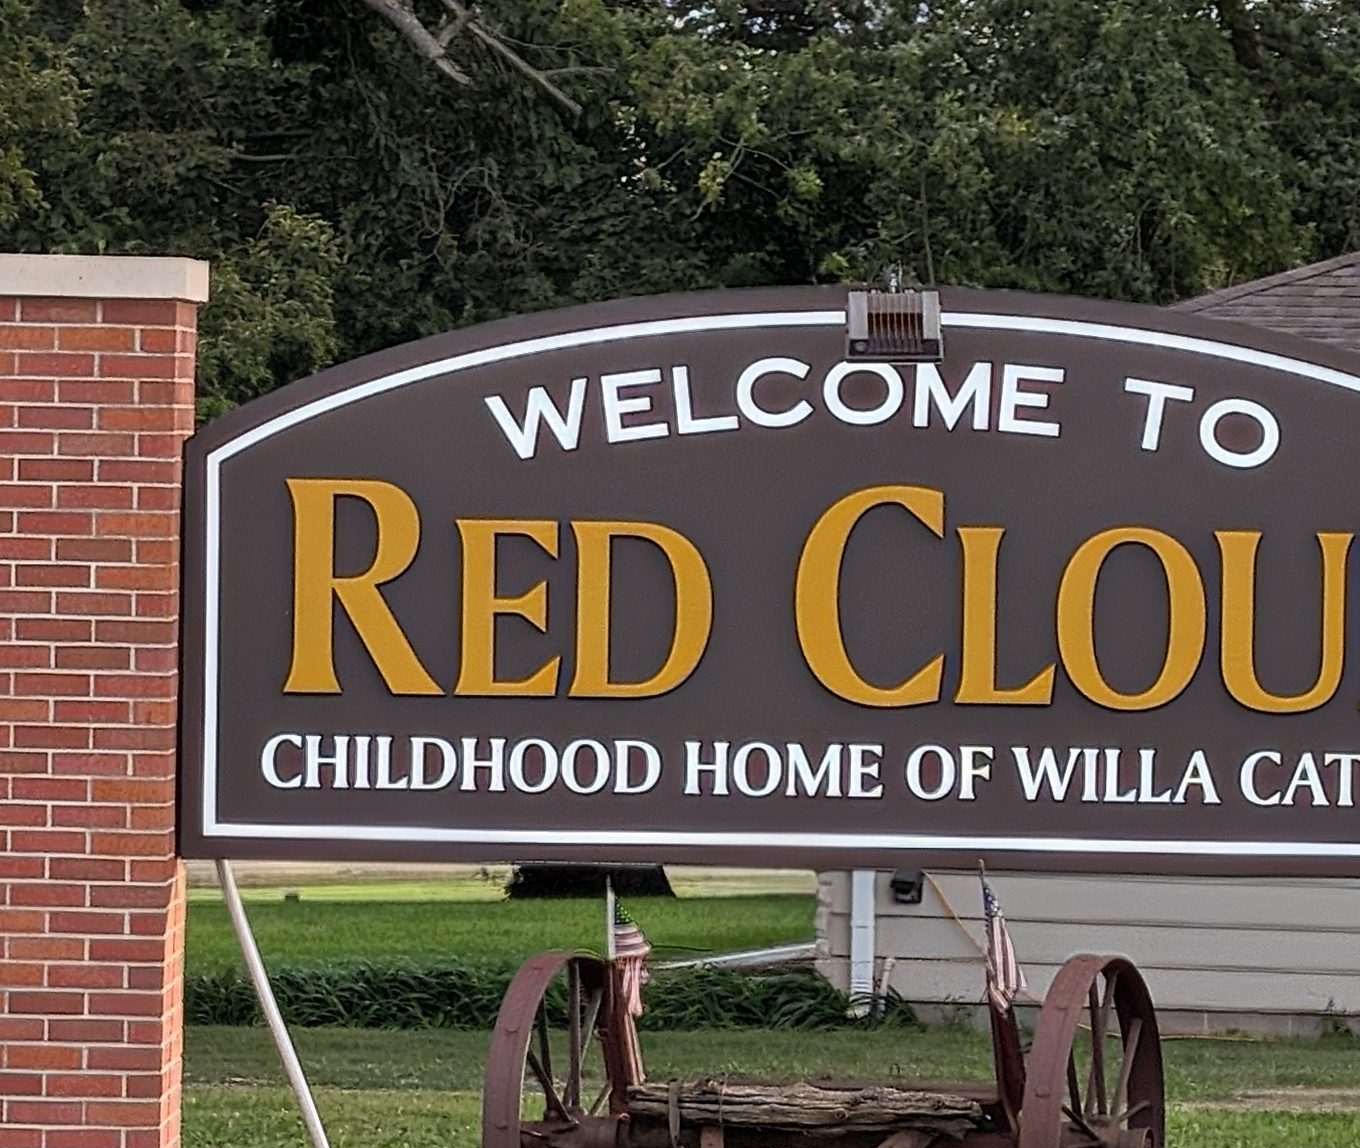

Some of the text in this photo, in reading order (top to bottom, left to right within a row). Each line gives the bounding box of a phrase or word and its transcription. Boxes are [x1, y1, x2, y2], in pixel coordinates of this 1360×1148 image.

[485, 357, 1280, 468] WELCOME TO
[282, 478, 714, 697] RED
[261, 733, 661, 794] CHILDHOOD
[684, 741, 885, 798] HOME
[905, 744, 995, 801] OF
[1011, 747, 1222, 804] WILLA
